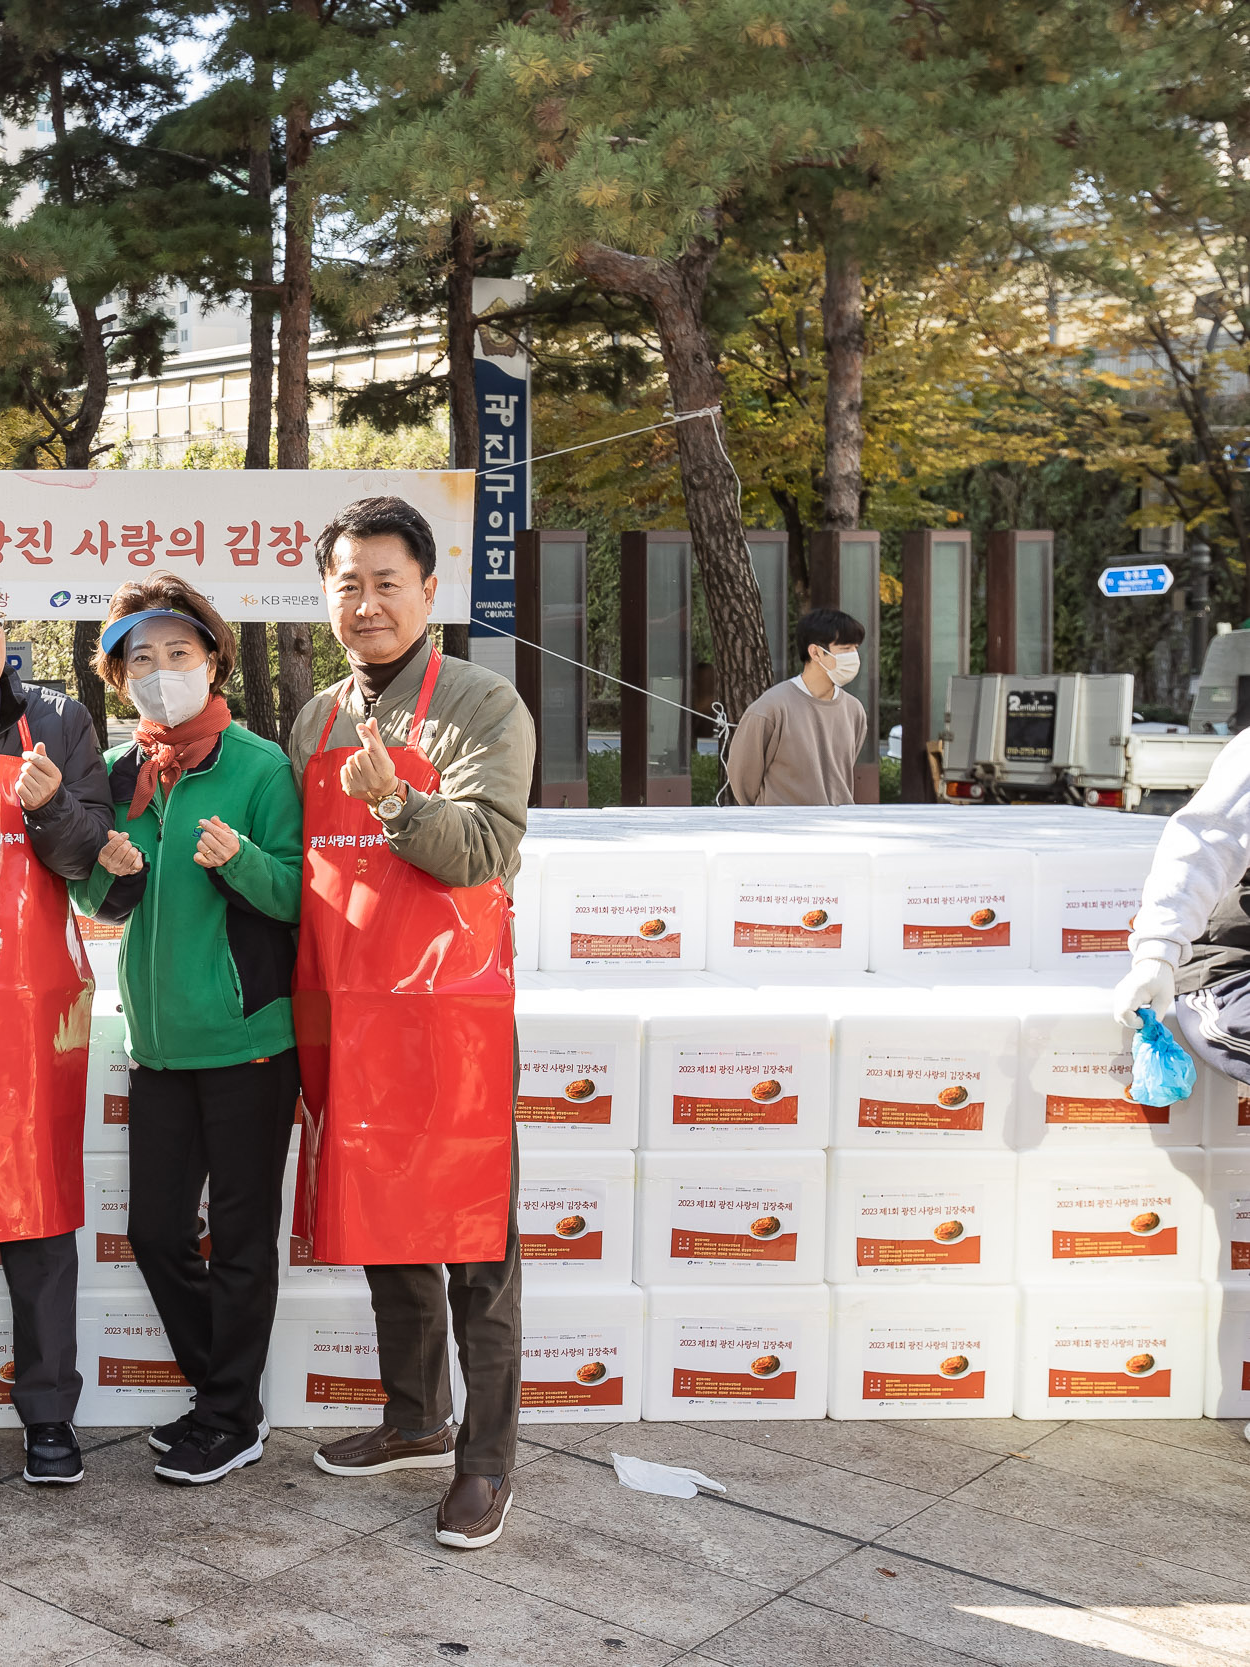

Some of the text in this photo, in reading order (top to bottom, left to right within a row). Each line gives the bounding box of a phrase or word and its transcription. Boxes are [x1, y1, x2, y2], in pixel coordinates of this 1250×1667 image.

[484, 394, 518, 581] 광진구의회
[70, 519, 205, 567] 사랑의
[224, 520, 316, 567] 김장
[310, 835, 326, 848] 광진
[327, 835, 356, 848] 사랑의
[697, 1065, 716, 1074] 제1회
[719, 1065, 734, 1074] 광진
[736, 1065, 759, 1074] 사랑의
[762, 1065, 792, 1074] 김장축제
[884, 1069, 904, 1078] 제1회
[906, 1070, 921, 1079] 광진
[923, 1070, 946, 1079] 사랑의
[950, 1071, 980, 1080] 김장축제
[696, 1200, 716, 1208] 제1회
[718, 1200, 733, 1209] 광진
[736, 1201, 759, 1210] 사랑의
[762, 1202, 792, 1211] 김장축제
[123, 1326, 143, 1336] 제1회
[145, 1327, 161, 1337] 광진
[313, 1343, 370, 1355] 2023 제1회 광진
[698, 1339, 717, 1348] 제1회
[719, 1340, 734, 1349] 광진
[736, 1340, 759, 1349] 사랑의
[763, 1341, 792, 1350] 김장축제
